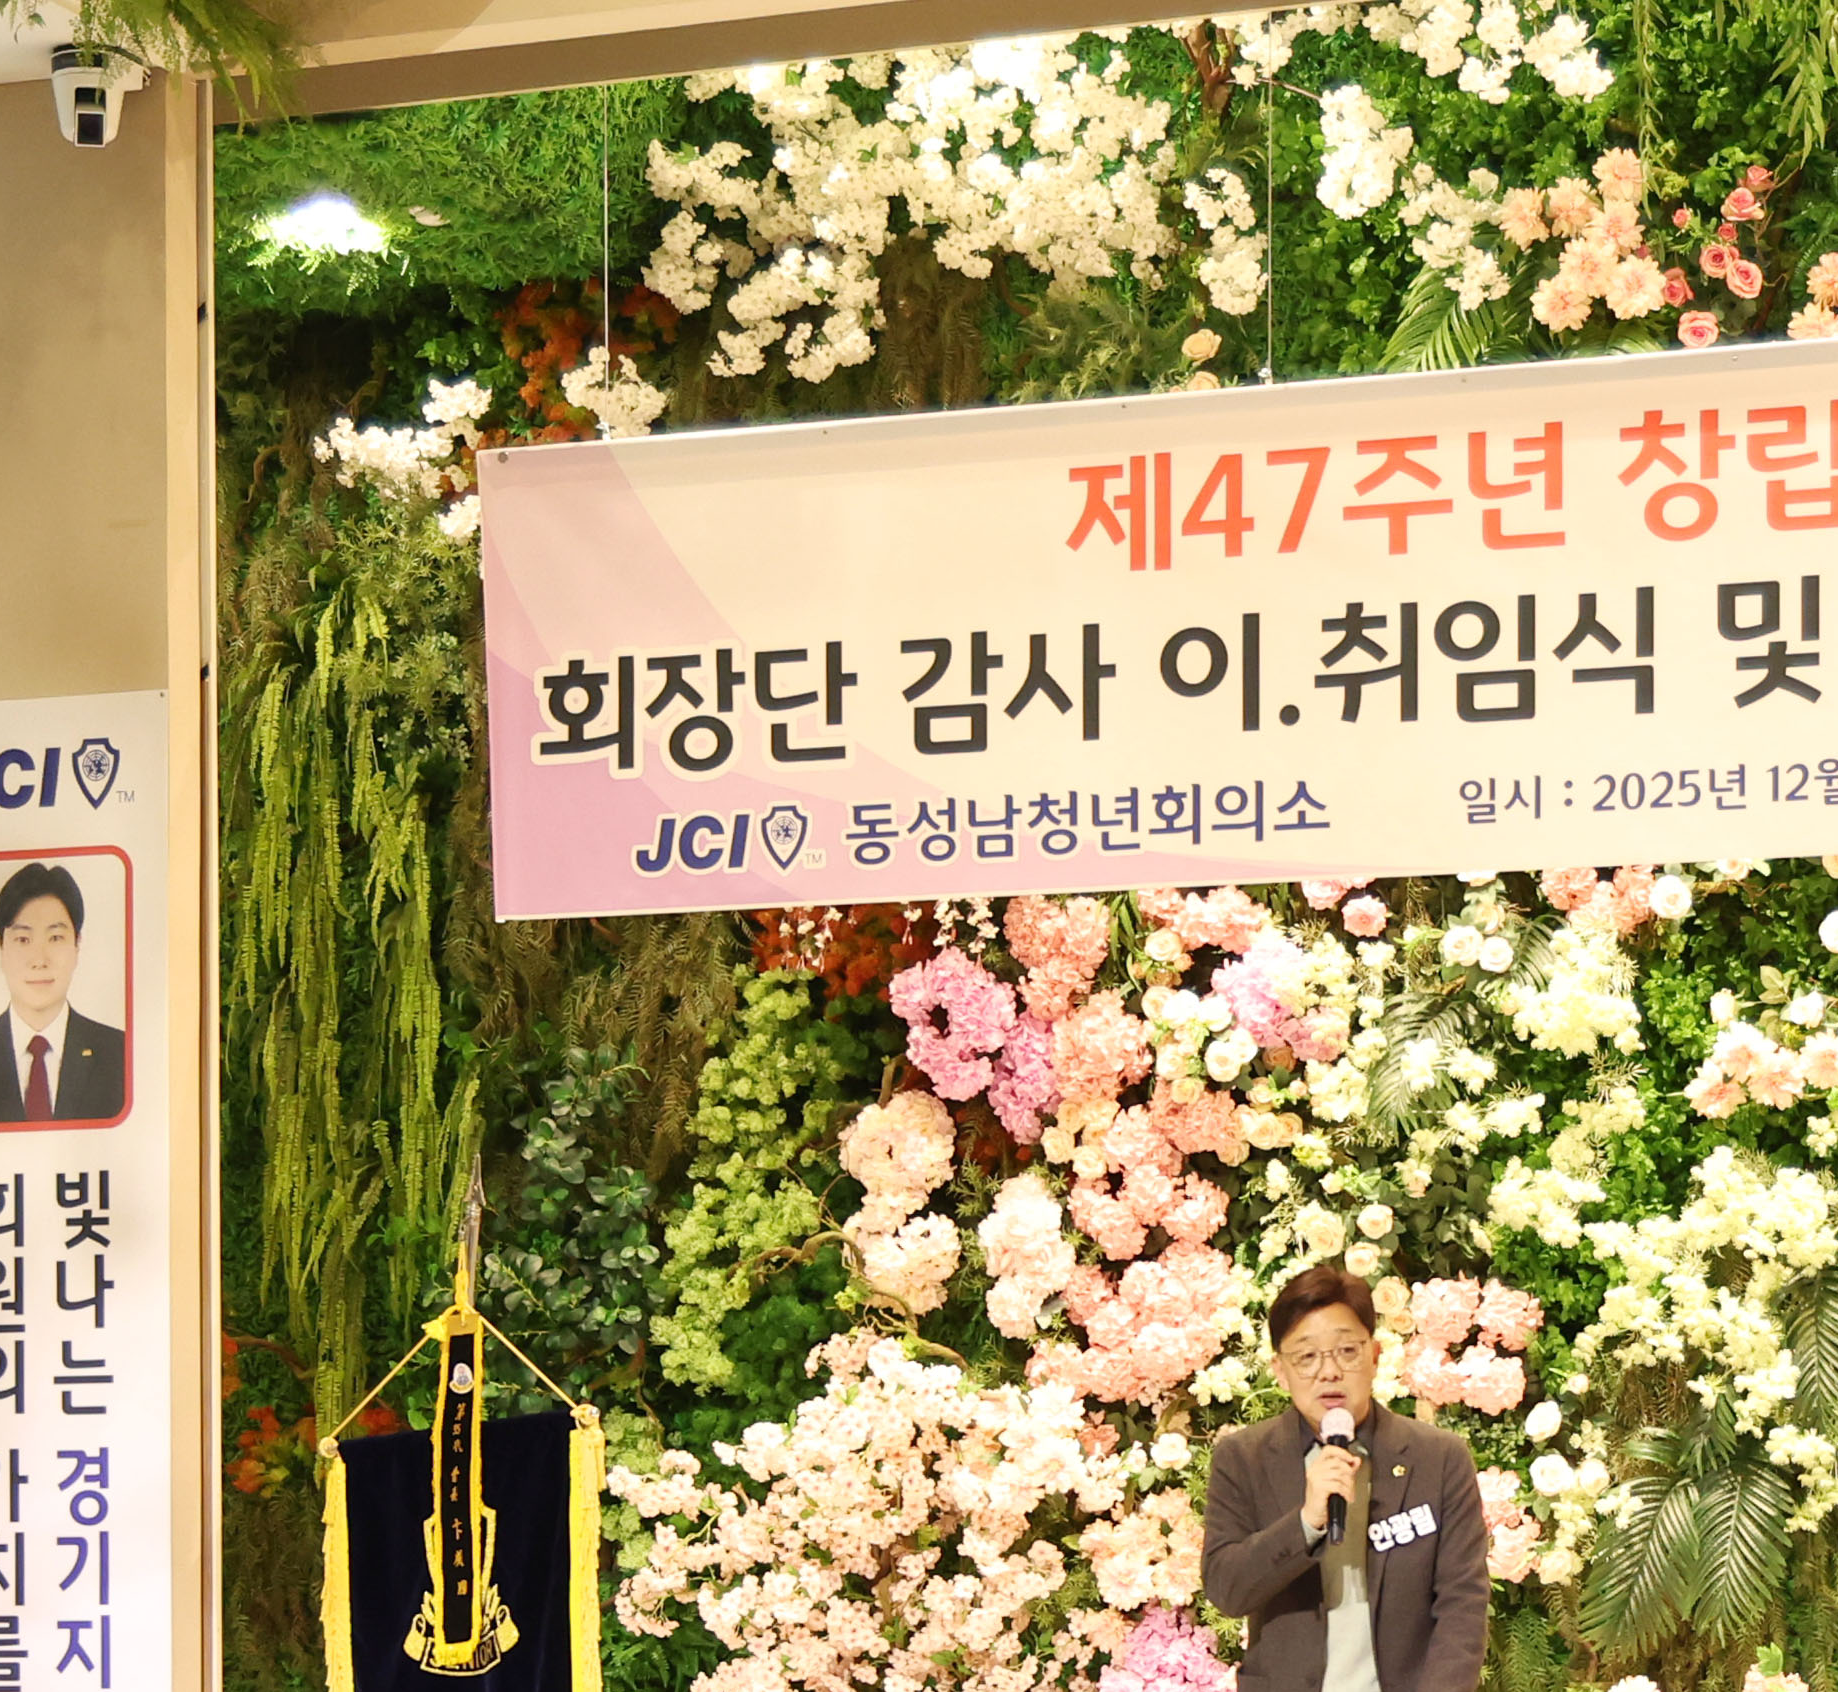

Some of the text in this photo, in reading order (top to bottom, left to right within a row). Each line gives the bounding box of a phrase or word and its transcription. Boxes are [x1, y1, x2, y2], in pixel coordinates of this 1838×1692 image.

[1065, 421, 1566, 571] 제47주년
[540, 641, 858, 771] 회장단
[900, 623, 1116, 755] 감사
[1160, 586, 1654, 731] 이.취임식
[1718, 575, 1821, 707] 및
[846, 780, 1330, 865] 동성남청년회의소
[1459, 775, 1541, 825] 일시
[1593, 763, 1747, 812] 2025년
[636, 814, 750, 872] JCI
[53, 1170, 115, 1415] 빛나는
[1368, 1503, 1437, 1552] 안광림
